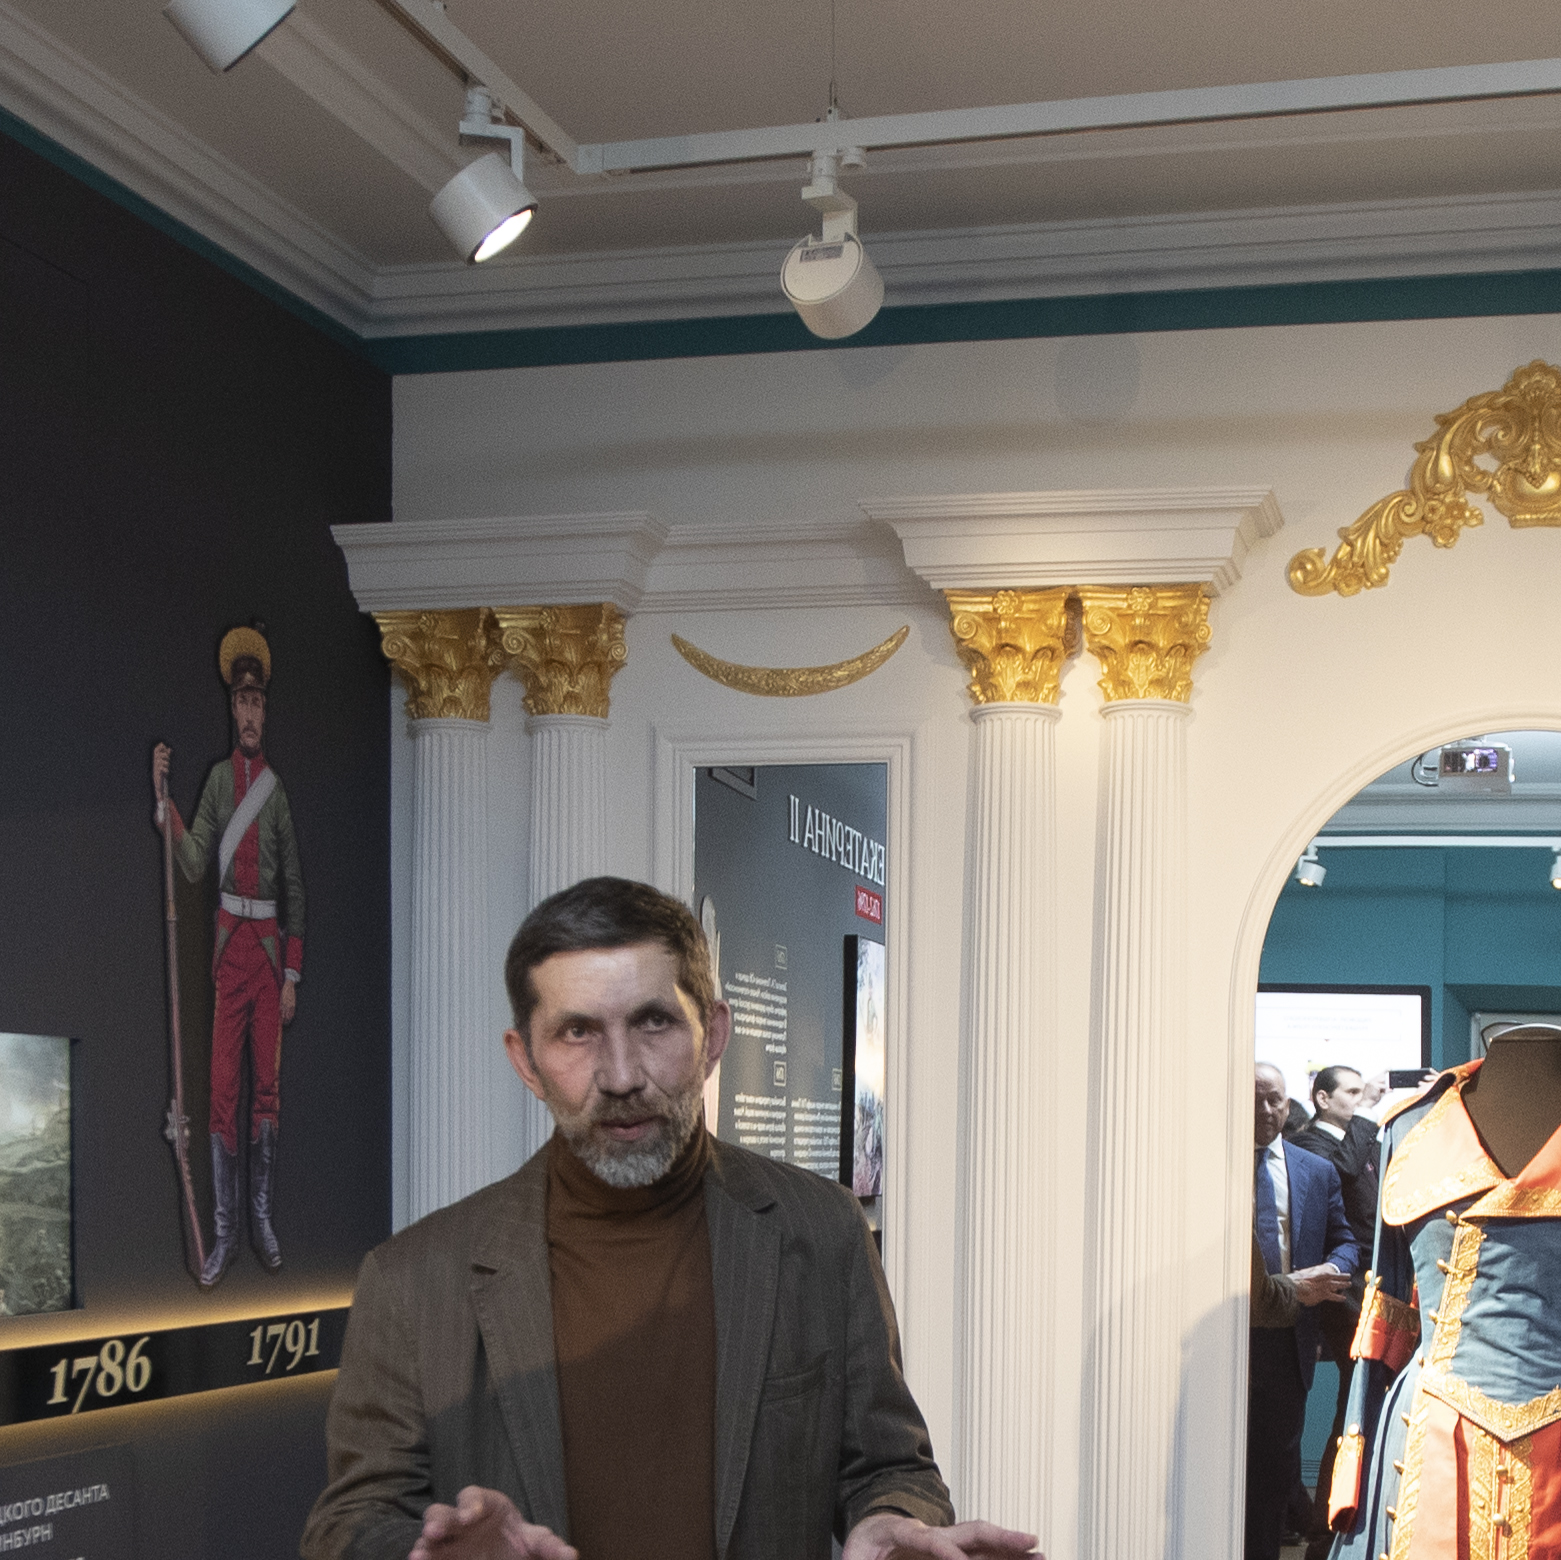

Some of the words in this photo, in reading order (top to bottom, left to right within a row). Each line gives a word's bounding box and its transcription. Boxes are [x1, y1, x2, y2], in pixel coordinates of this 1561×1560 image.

[247, 1318, 320, 1374] 1791
[47, 1336, 151, 1414] 1786
[45, 1483, 110, 1516] ДЕСАНТА
